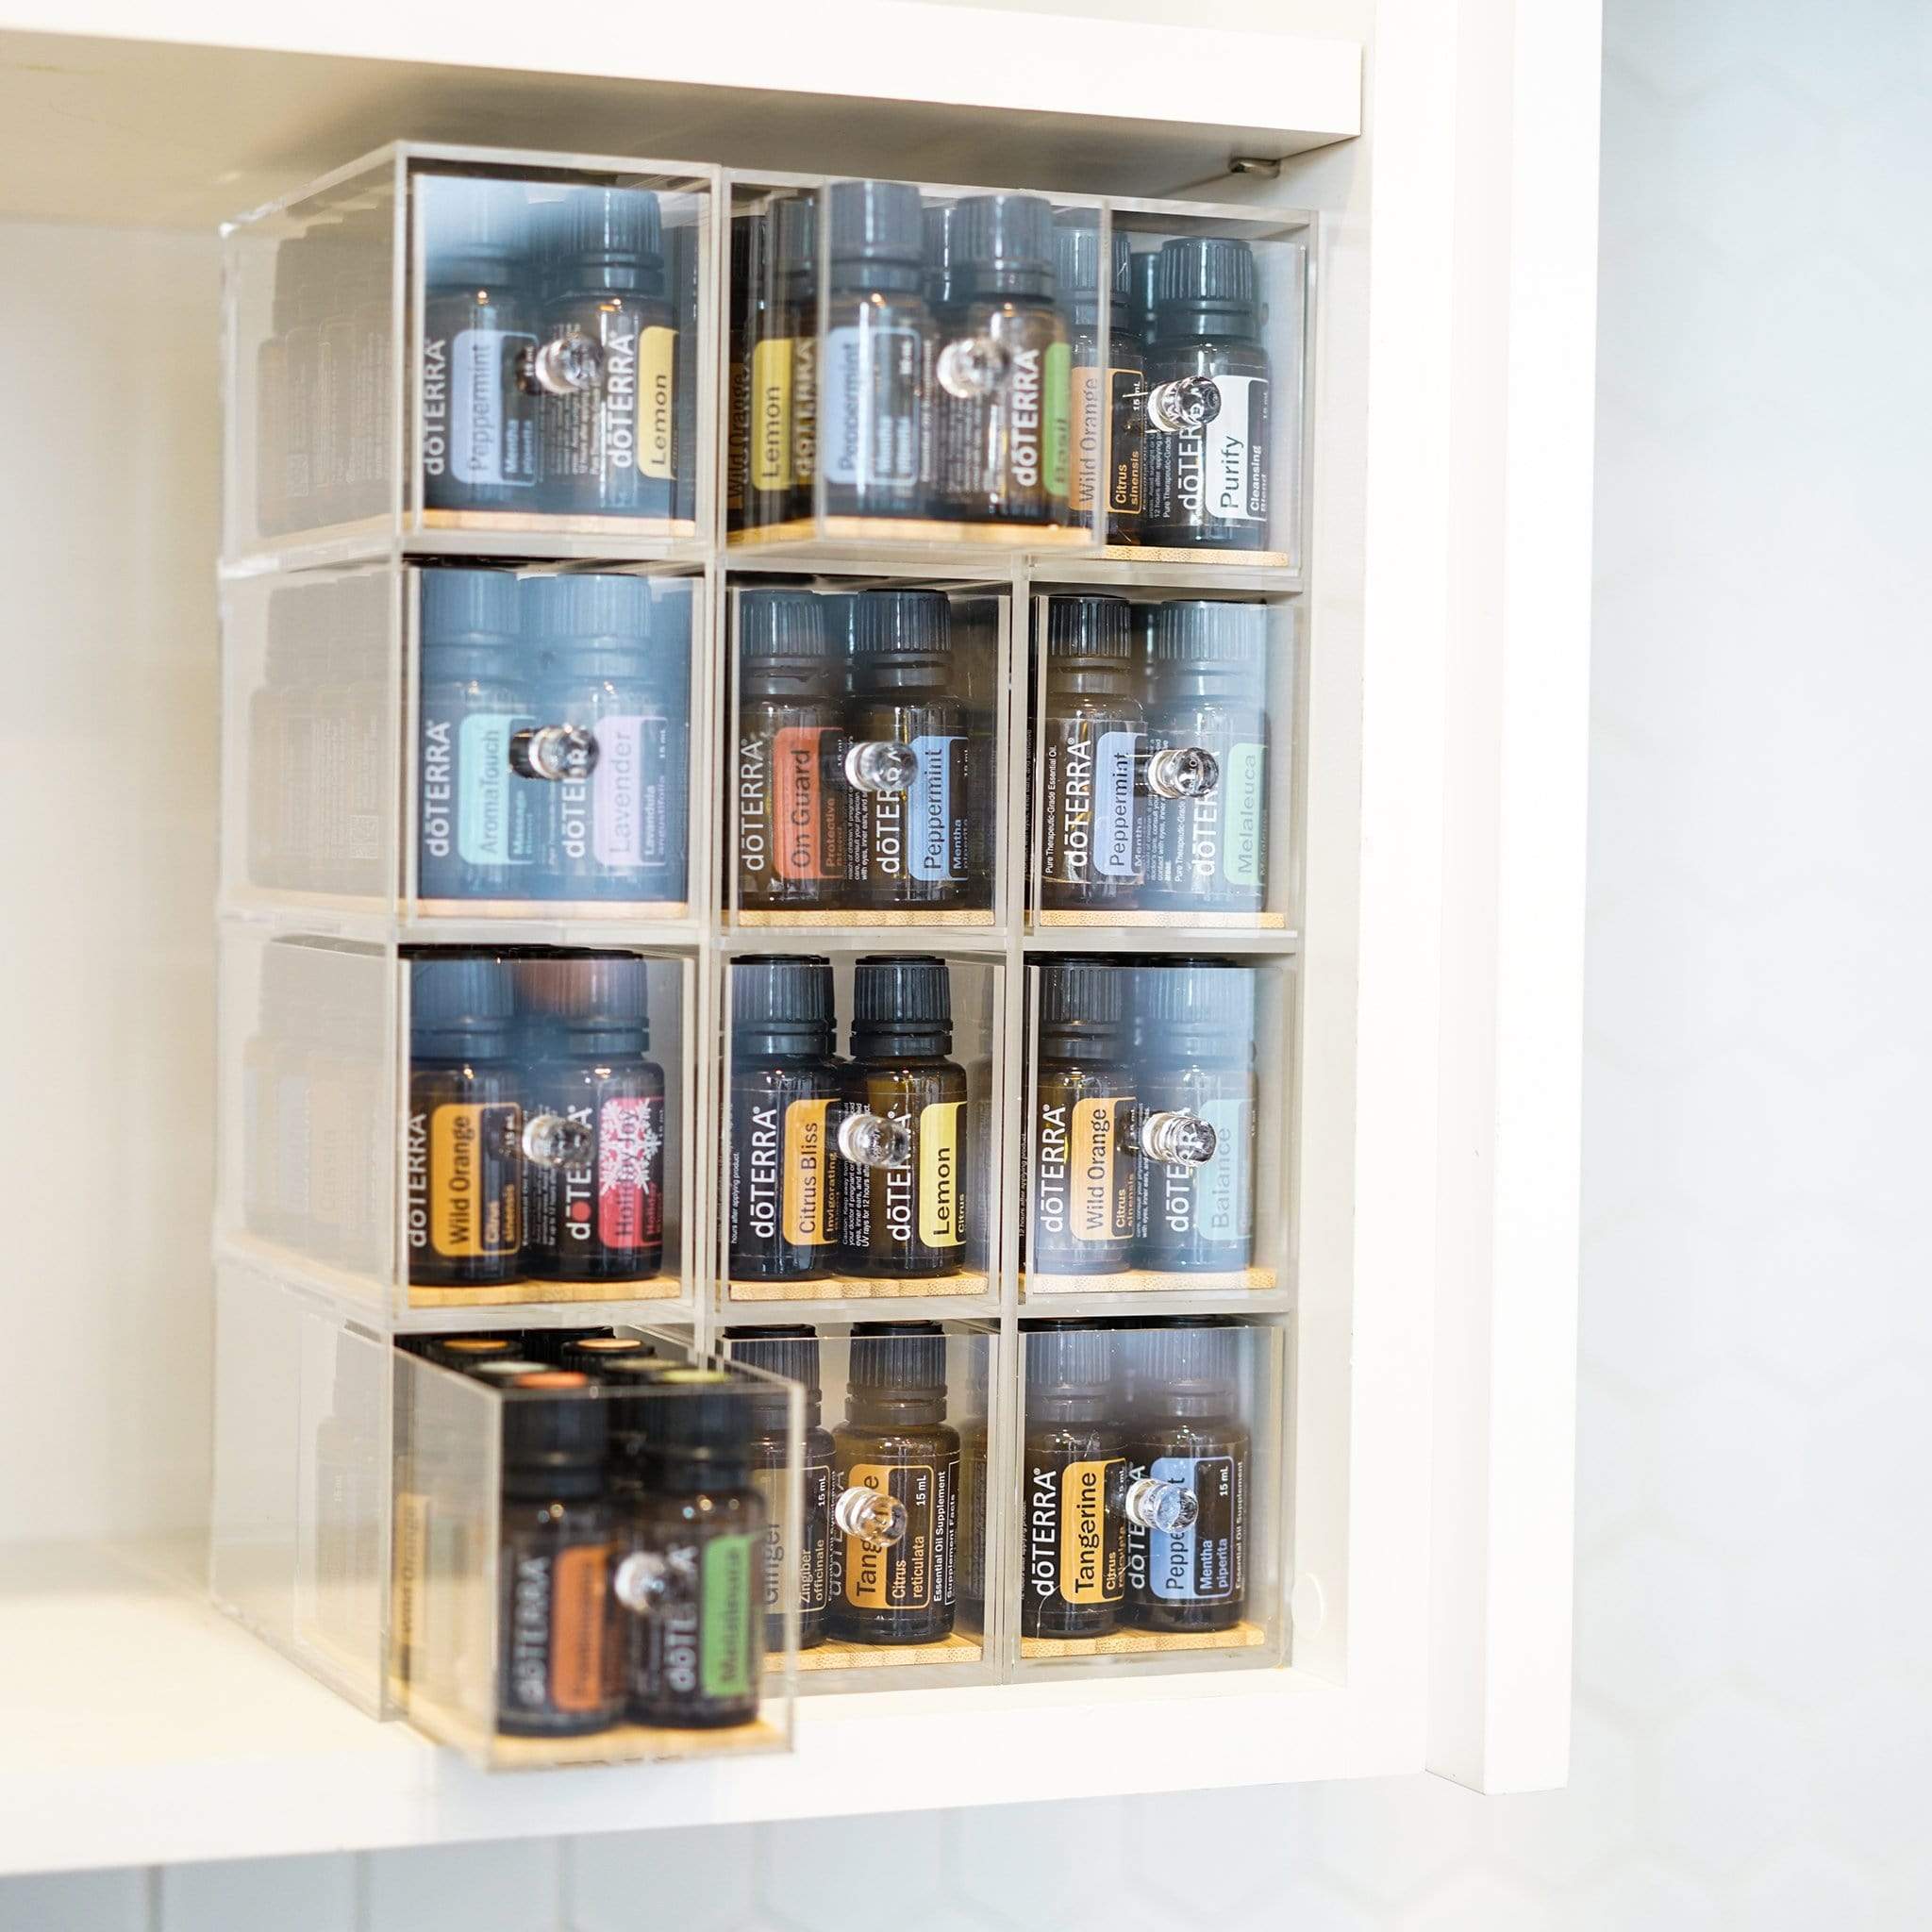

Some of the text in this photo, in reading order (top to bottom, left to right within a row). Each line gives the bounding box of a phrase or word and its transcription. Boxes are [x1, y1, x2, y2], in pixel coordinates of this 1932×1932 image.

[468, 344, 496, 471] Peppermint
[650, 375, 667, 465] Lemon
[762, 387, 780, 477] Lemon
[1078, 378, 1099, 502] Wild Orange
[1133, 398, 1141, 411] 15
[1114, 464, 1128, 504] Citrus
[1130, 451, 1141, 506] sinensis
[1163, 436, 1172, 500] Therapeutic-Grade
[1220, 436, 1244, 508] Purify
[1250, 445, 1261, 511] Cleansing
[480, 730, 501, 854] AromaTouch
[609, 731, 633, 854] Lavender
[791, 750, 811, 868] On Guard
[924, 749, 945, 869] Peppermint
[1045, 745, 1057, 874] Pure Therapeutic-Grade Essential Oil.
[1109, 753, 1129, 866] Peppermint
[1239, 754, 1256, 874] Melaleuca
[825, 798, 837, 868] Protective
[953, 820, 962, 869] Mentha
[1134, 817, 1142, 867] Mentha
[1174, 801, 1186, 882] Pure Therapeutic-Grade
[448, 1116, 475, 1245] Wild Orange
[566, 1111, 592, 1240] dōTEA
[732, 1179, 741, 1208] applying
[799, 1123, 818, 1234] Citrus Bliss
[826, 1152, 838, 1232] Invigorating
[933, 1147, 951, 1236] Lemon
[1086, 1108, 1110, 1230] Wild Orange
[1211, 1128, 1231, 1229] Balance
[855, 1229, 863, 1247] eyes,
[862, 1235, 870, 1247] UV
[1115, 1189, 1125, 1228] Citrus
[1141, 1207, 1150, 1224] eyes,
[817, 1474, 826, 1507] 15 mL
[916, 1474, 926, 1507] 15 mL
[1219, 1466, 1229, 1497] 15 mL
[857, 1474, 882, 1597] Tange
[933, 1471, 946, 1602] Essential Oil Supplement
[1074, 1472, 1100, 1593] Tangerine
[1127, 1465, 1146, 1589] dōTEA
[1166, 1477, 1189, 1590] Peppet
[799, 1549, 813, 1604] Zingiber
[814, 1540, 824, 1602] officinale
[891, 1559, 907, 1599] Citrus
[911, 1535, 925, 1598] reticulata
[946, 1529, 955, 1598] Supplement
[1106, 1552, 1117, 1591] Citrus
[1200, 1540, 1213, 1590] Mentha
[1216, 1539, 1229, 1588] piperita
